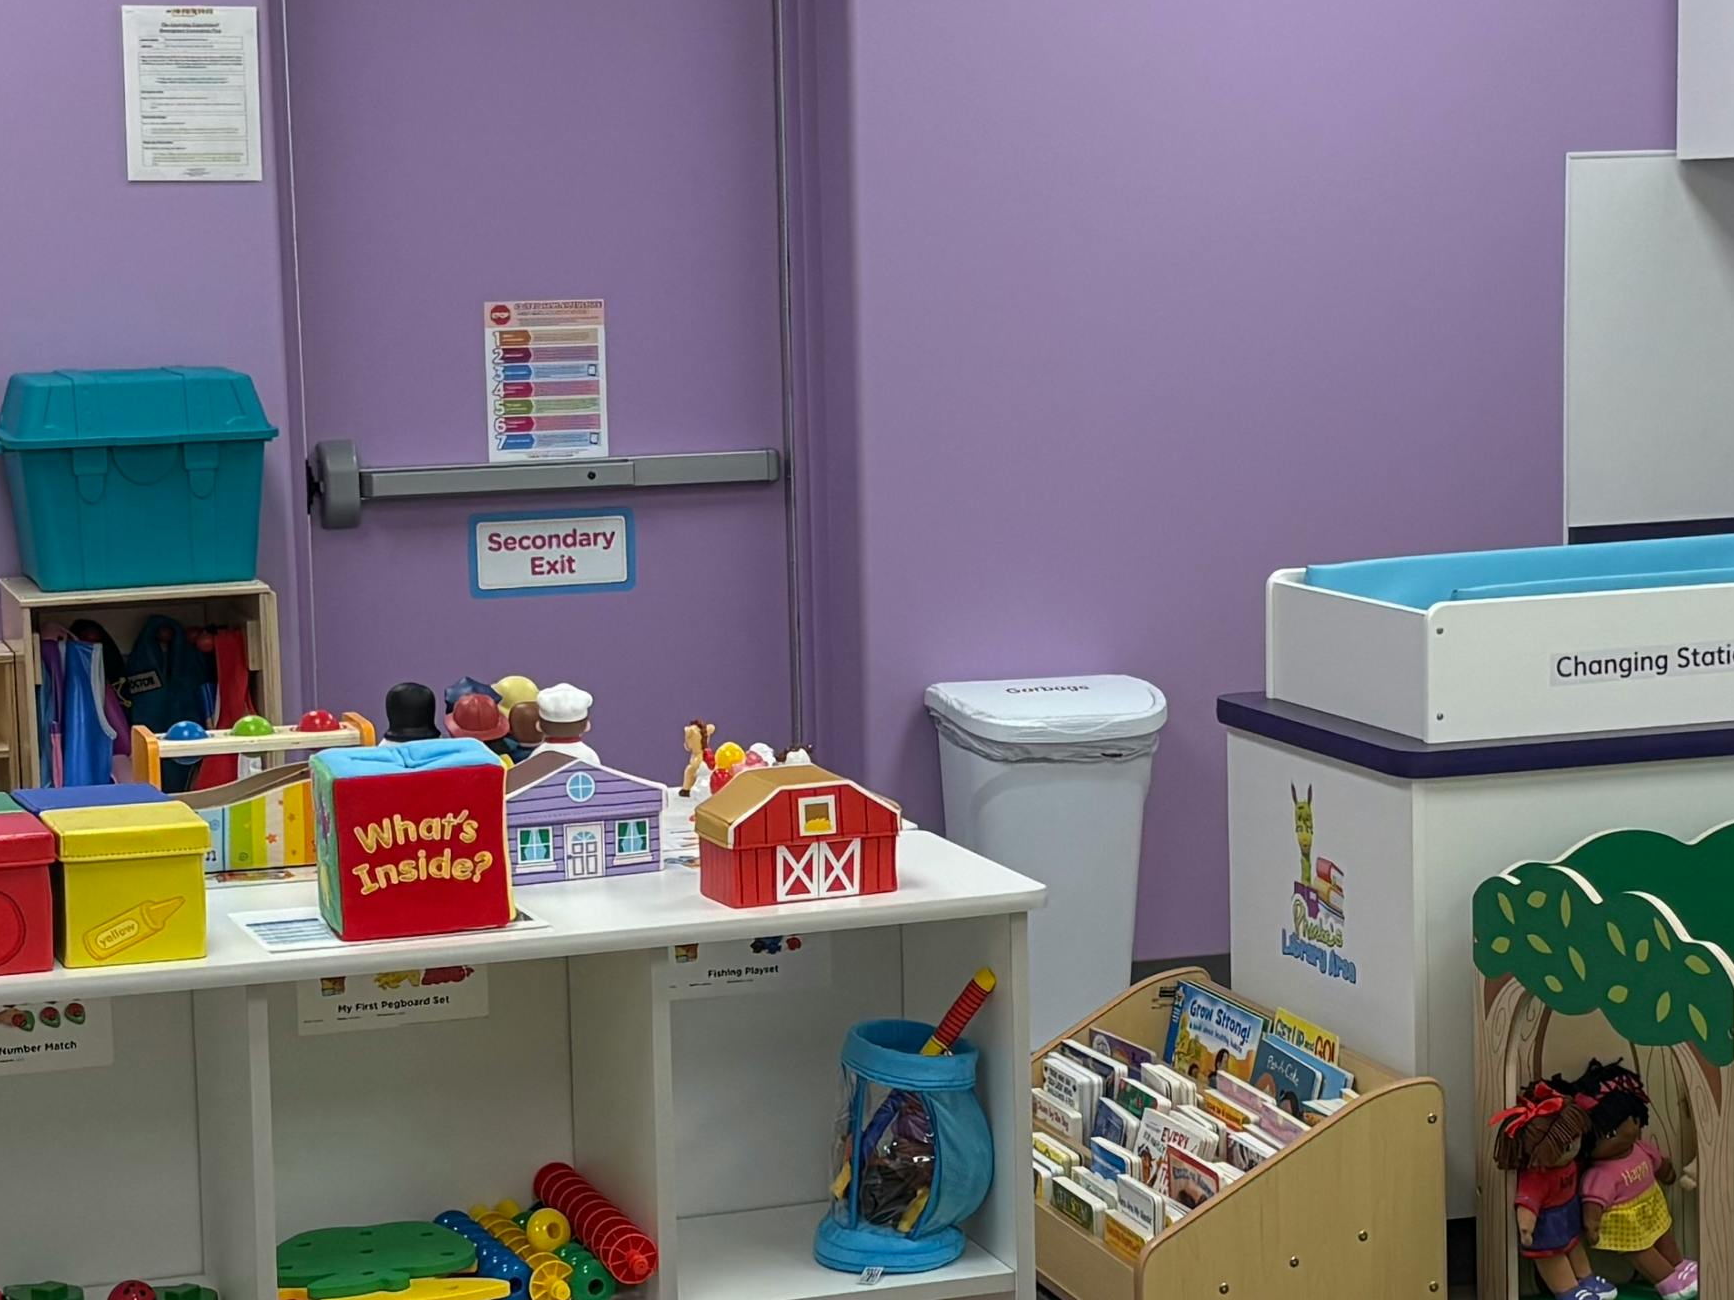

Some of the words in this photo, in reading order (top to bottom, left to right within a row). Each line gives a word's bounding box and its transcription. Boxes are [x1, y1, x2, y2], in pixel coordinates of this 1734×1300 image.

[493, 331, 500, 347] 1
[492, 348, 504, 364] 2
[492, 382, 504, 399] 4
[494, 400, 505, 416] 5
[495, 417, 506, 433] 6
[497, 435, 508, 450] 7
[486, 527, 616, 552] Secondary
[530, 554, 576, 576] Exit
[1556, 651, 1669, 679] Changing
[1005, 684, 1090, 694] Garbage
[353, 809, 479, 854] What's
[352, 847, 493, 895] Inside?
[99, 923, 135, 948] yellow
[1281, 928, 1327, 974] Library
[707, 966, 743, 979] Fishing
[744, 965, 779, 976] Playset
[337, 1004, 353, 1014] My
[355, 1001, 379, 1012] First
[381, 997, 430, 1010] Pegboard
[433, 995, 450, 1005] Set
[1189, 999, 1215, 1022] Grow
[1216, 1008, 1252, 1046] Strong!
[44, 1040, 77, 1052] Match
